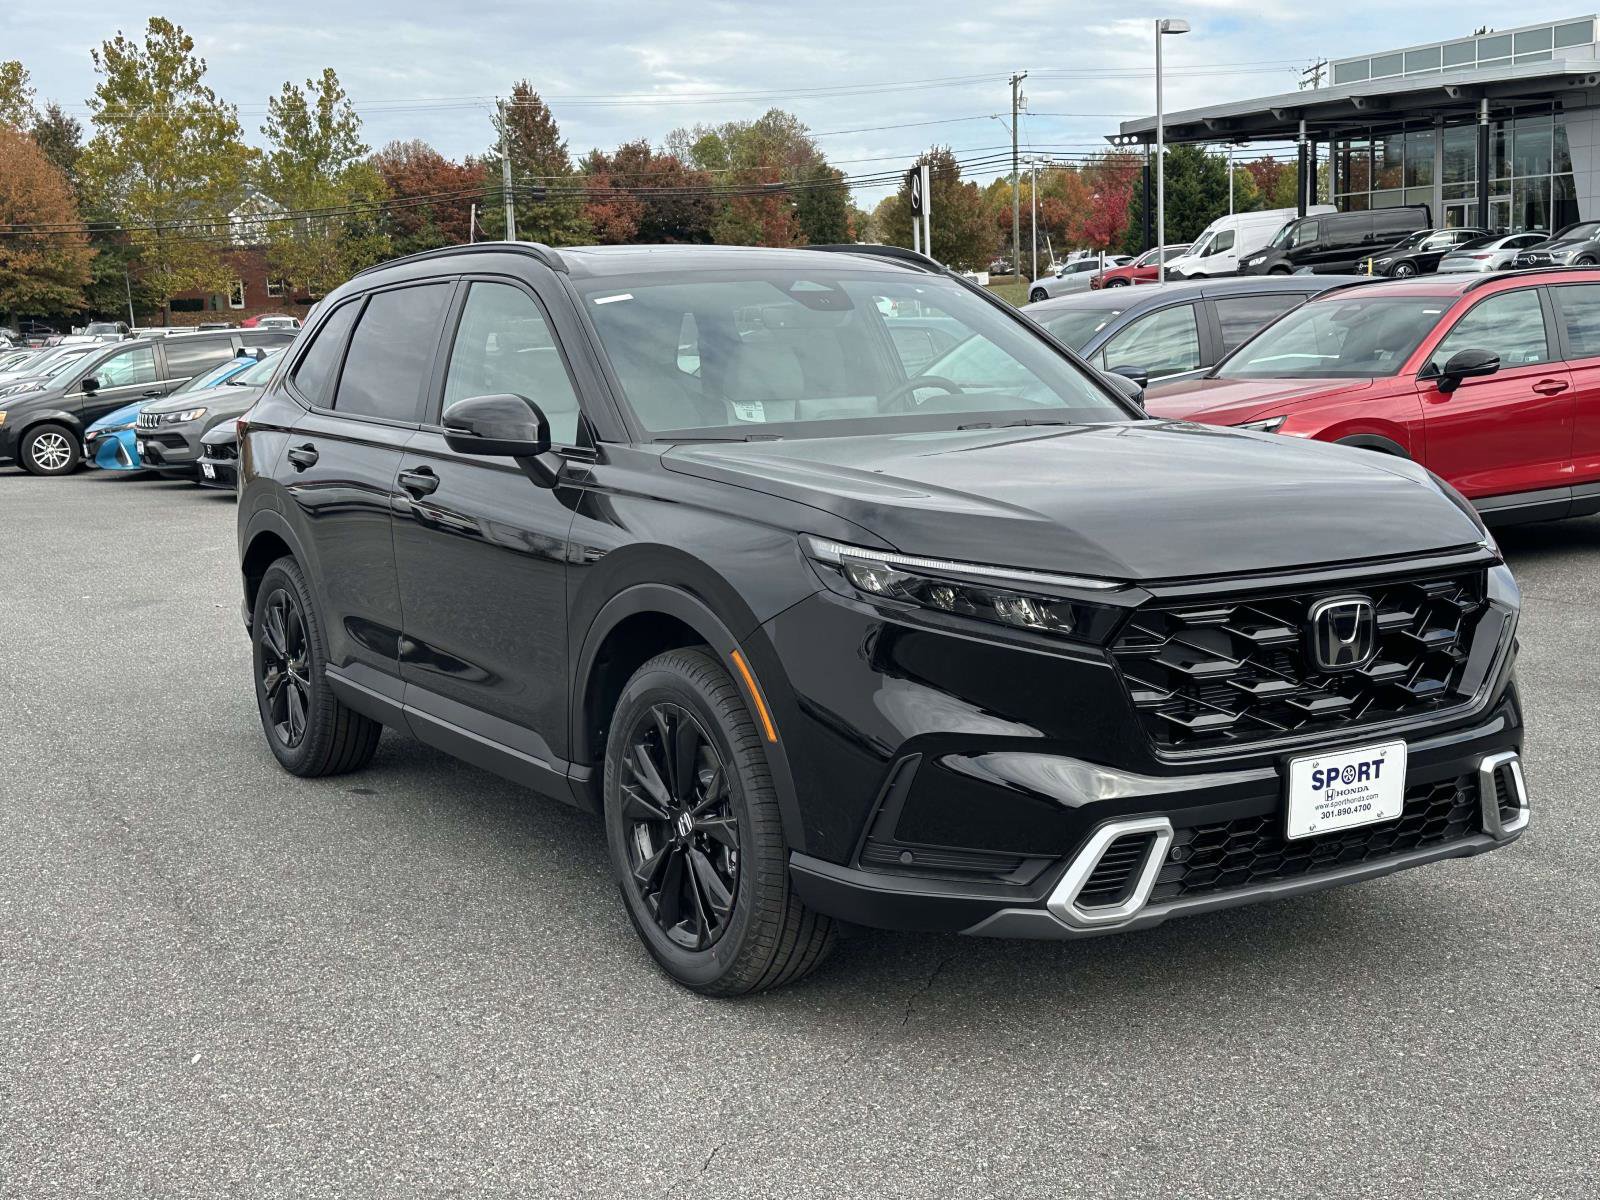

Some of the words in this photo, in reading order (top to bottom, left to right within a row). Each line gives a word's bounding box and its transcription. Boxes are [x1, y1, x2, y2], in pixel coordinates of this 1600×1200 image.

[1312, 759, 1384, 790] SPORT
[1336, 786, 1369, 797] HONDA
[1315, 793, 1378, 810] www.sporthonda.com
[1321, 803, 1371, 819] 301.890.4700
